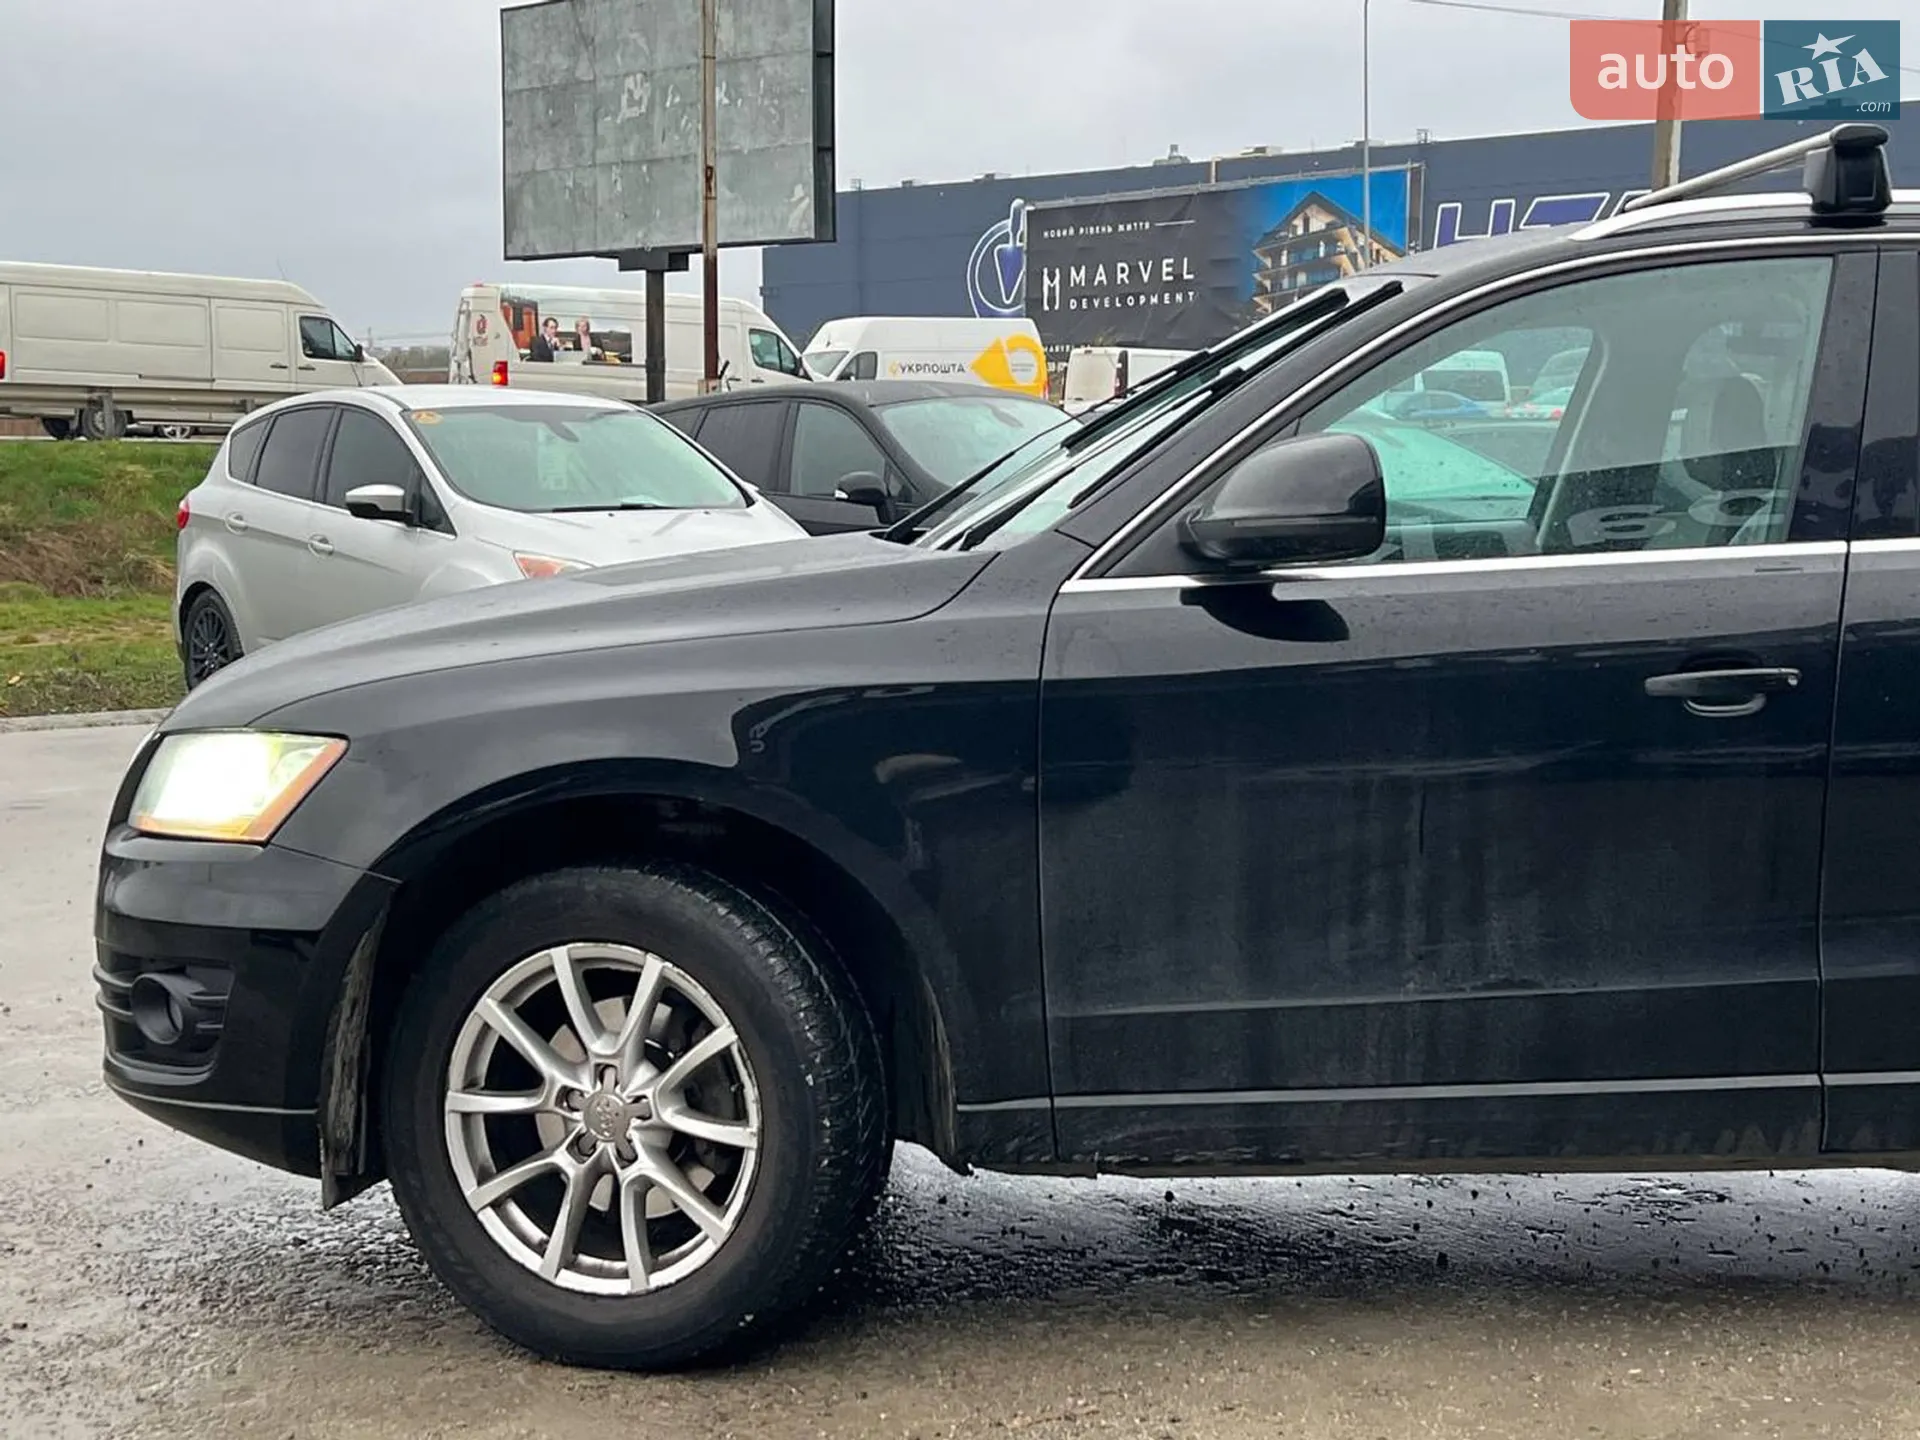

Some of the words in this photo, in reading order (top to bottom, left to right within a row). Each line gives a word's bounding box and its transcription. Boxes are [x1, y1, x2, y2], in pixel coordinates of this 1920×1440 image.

[1043, 225, 1075, 239] НОВИЙ
[1070, 257, 1195, 287] MARVEL
[1069, 291, 1195, 310] DEVELOPMENT
[900, 363, 966, 374] УКРПОШТА
